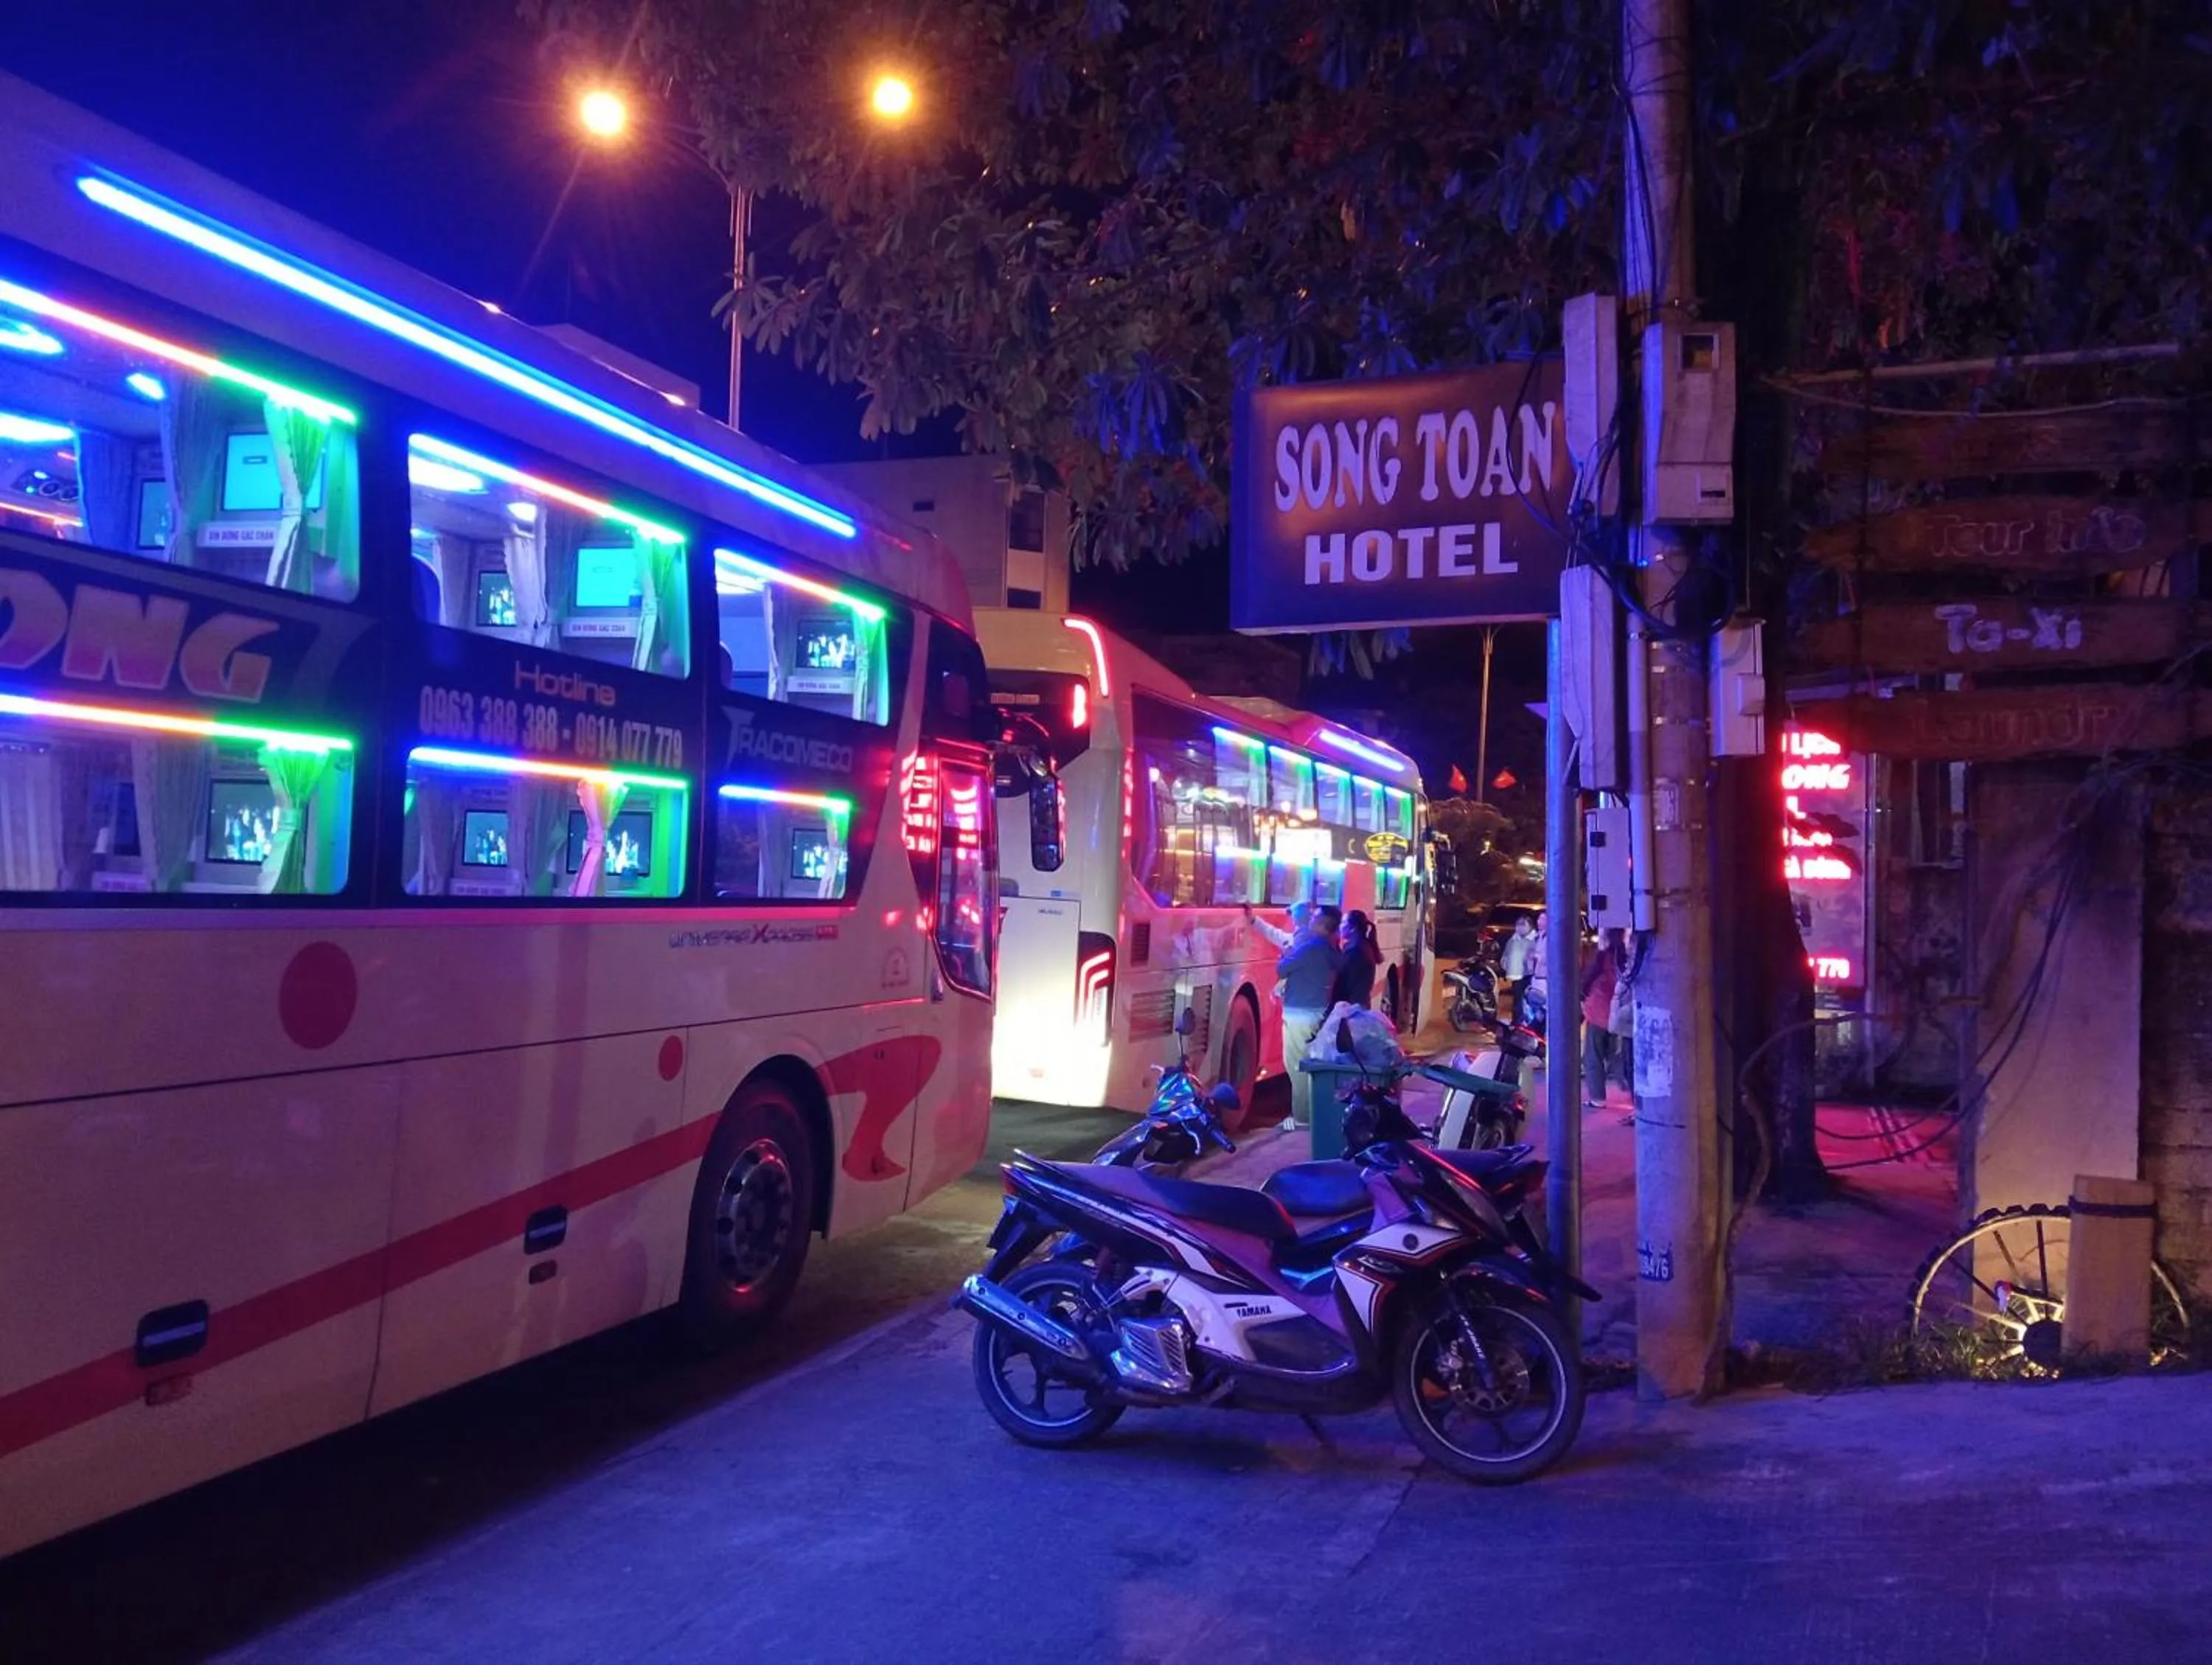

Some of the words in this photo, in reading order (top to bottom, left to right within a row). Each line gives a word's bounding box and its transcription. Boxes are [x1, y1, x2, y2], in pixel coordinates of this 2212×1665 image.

[1274, 417, 1401, 512] SONG
[1416, 401, 1556, 501] TOAN
[1304, 522, 1518, 585] HOTEL
[515, 660, 616, 707] Hotline
[420, 684, 475, 740] 0963
[522, 702, 560, 752] 388
[574, 712, 617, 761] 0914
[622, 719, 651, 765] 077
[654, 726, 683, 770] 779
[720, 705, 853, 773] TRACOMECO
[1237, 1305, 1272, 1317] YAMAHA
